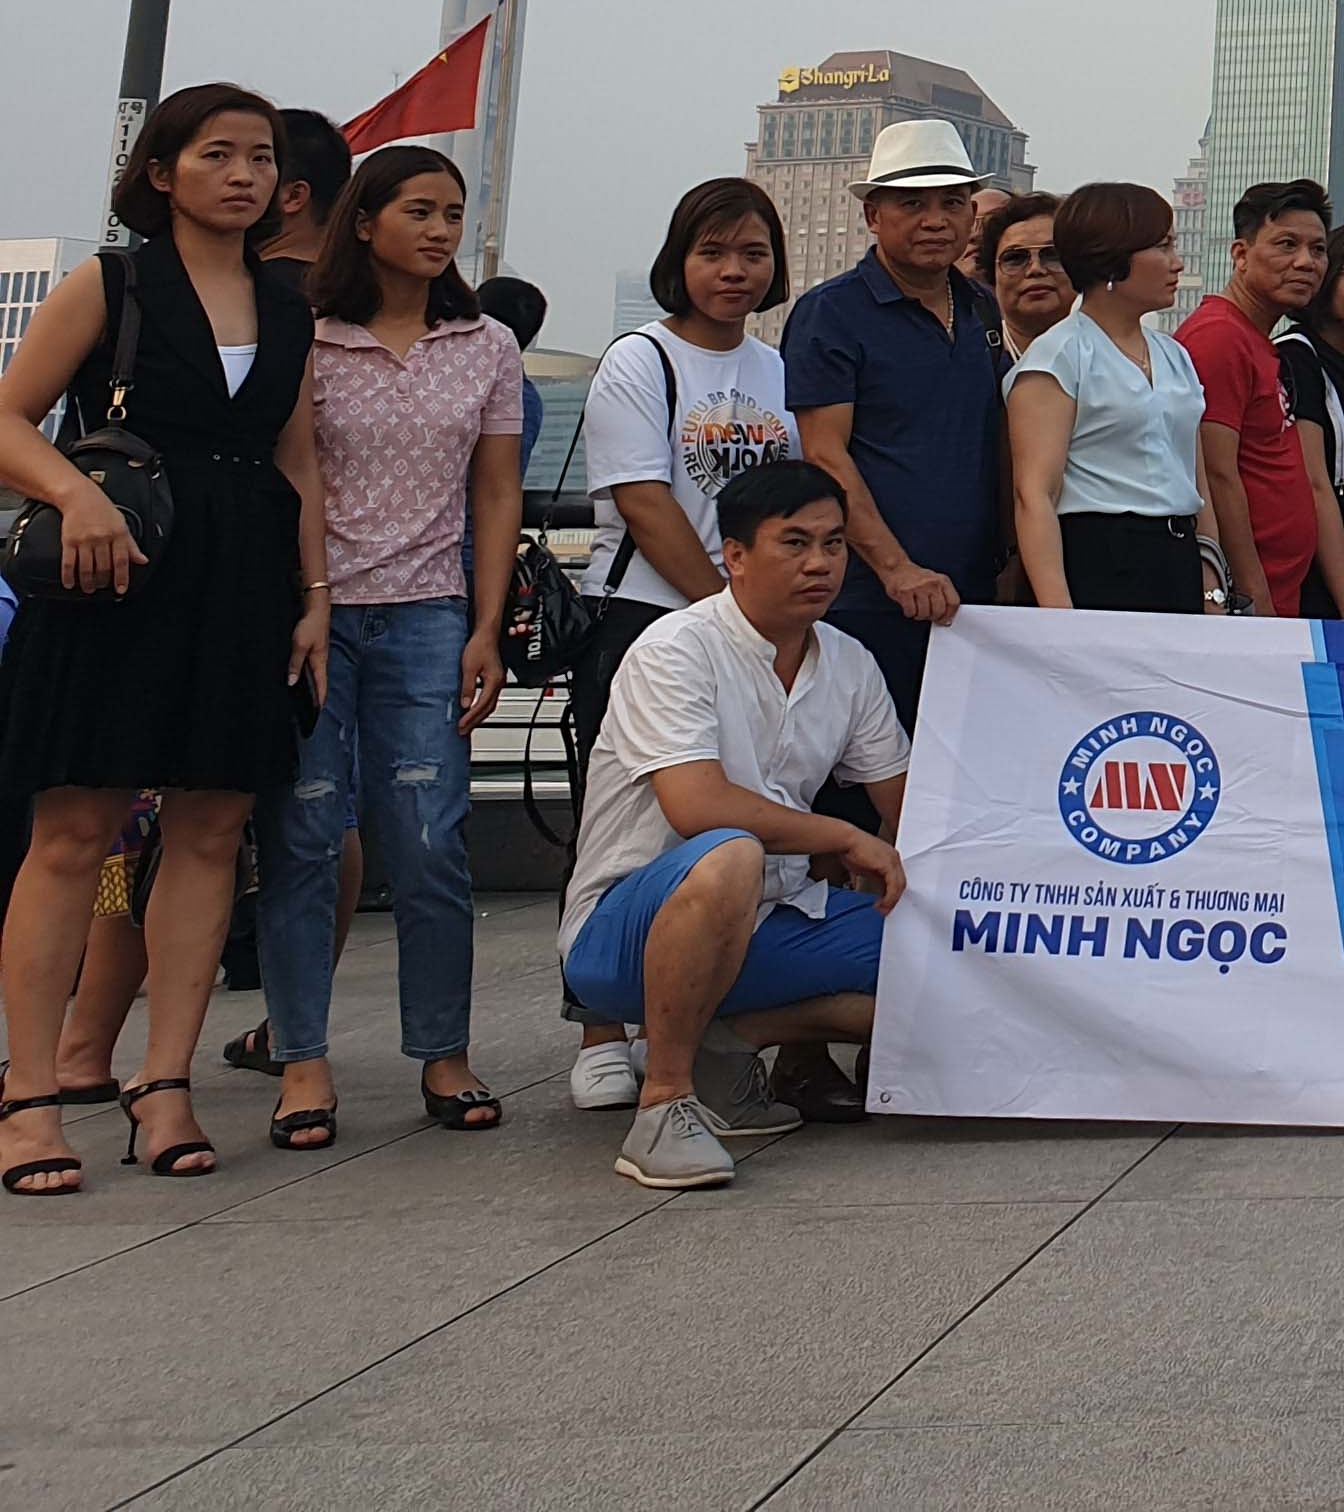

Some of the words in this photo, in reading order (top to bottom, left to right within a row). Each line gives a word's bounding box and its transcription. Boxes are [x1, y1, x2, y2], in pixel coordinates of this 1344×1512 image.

[800, 63, 890, 89] Shangri-La
[704, 422, 764, 446] new
[1071, 717, 1138, 770] MINH
[1149, 716, 1214, 774] NGỌC
[1068, 810, 1203, 861] COMPANY
[958, 877, 1005, 902] CÔNG
[1009, 883, 1033, 904] TY
[1034, 884, 1081, 906] TNHH
[1083, 880, 1118, 907] SẢN
[1120, 882, 1166, 909] XUẤT
[1169, 889, 1181, 909] &
[1185, 889, 1250, 912] THƯƠNG
[1253, 892, 1285, 917] MẠI
[952, 909, 1110, 957] MINH
[1123, 917, 1288, 975] NGỌC
